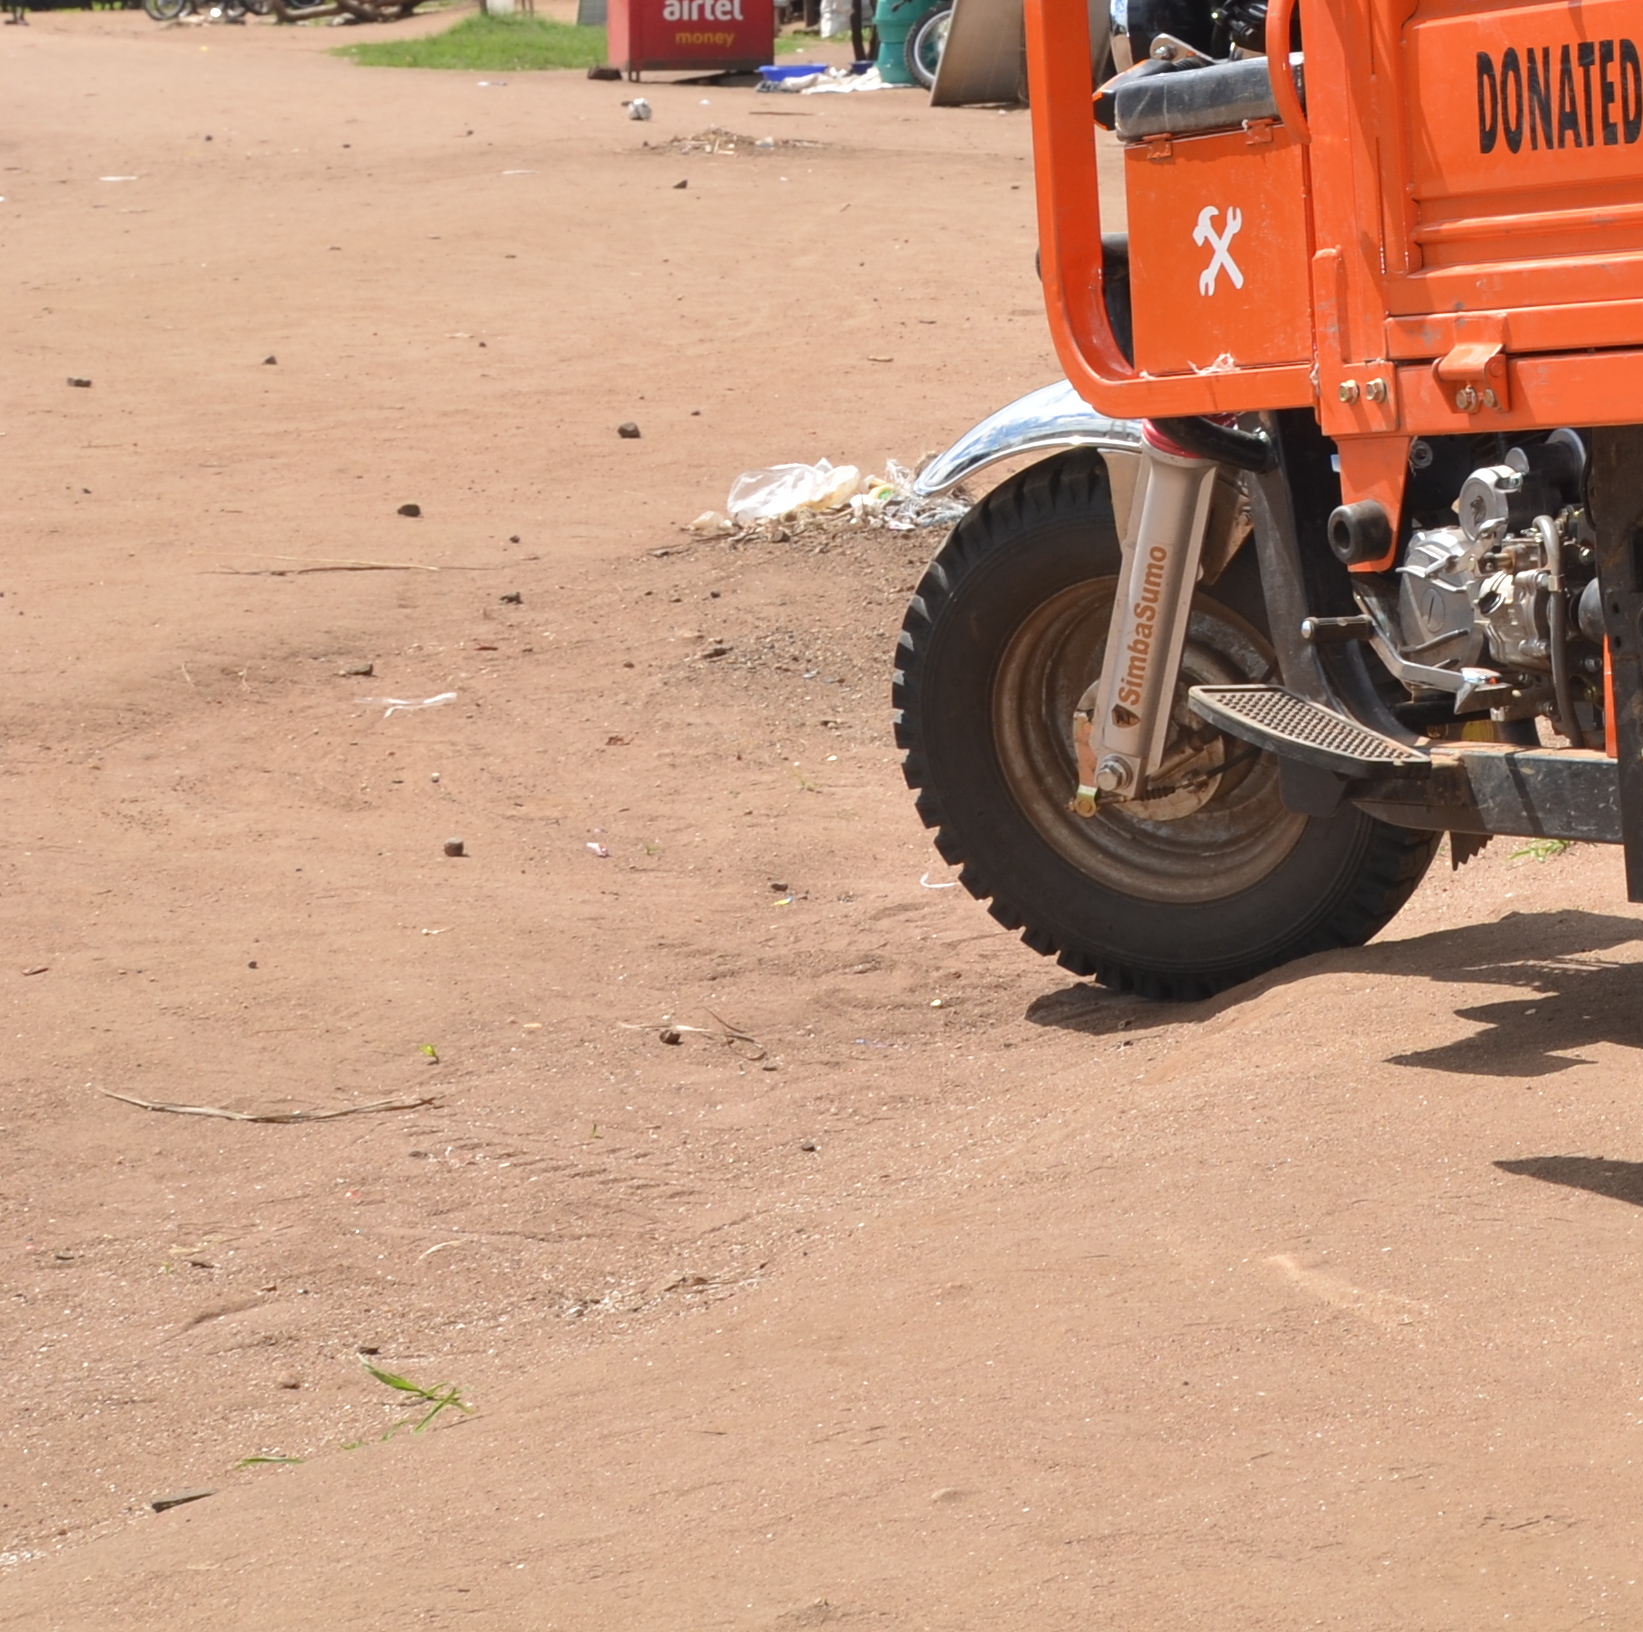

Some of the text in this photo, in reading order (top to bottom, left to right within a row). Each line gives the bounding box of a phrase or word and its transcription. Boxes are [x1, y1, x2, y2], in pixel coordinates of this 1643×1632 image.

[675, 31, 735, 47] money
[1476, 37, 1643, 155] DONATED
[1118, 546, 1167, 706] SimbaSumo
